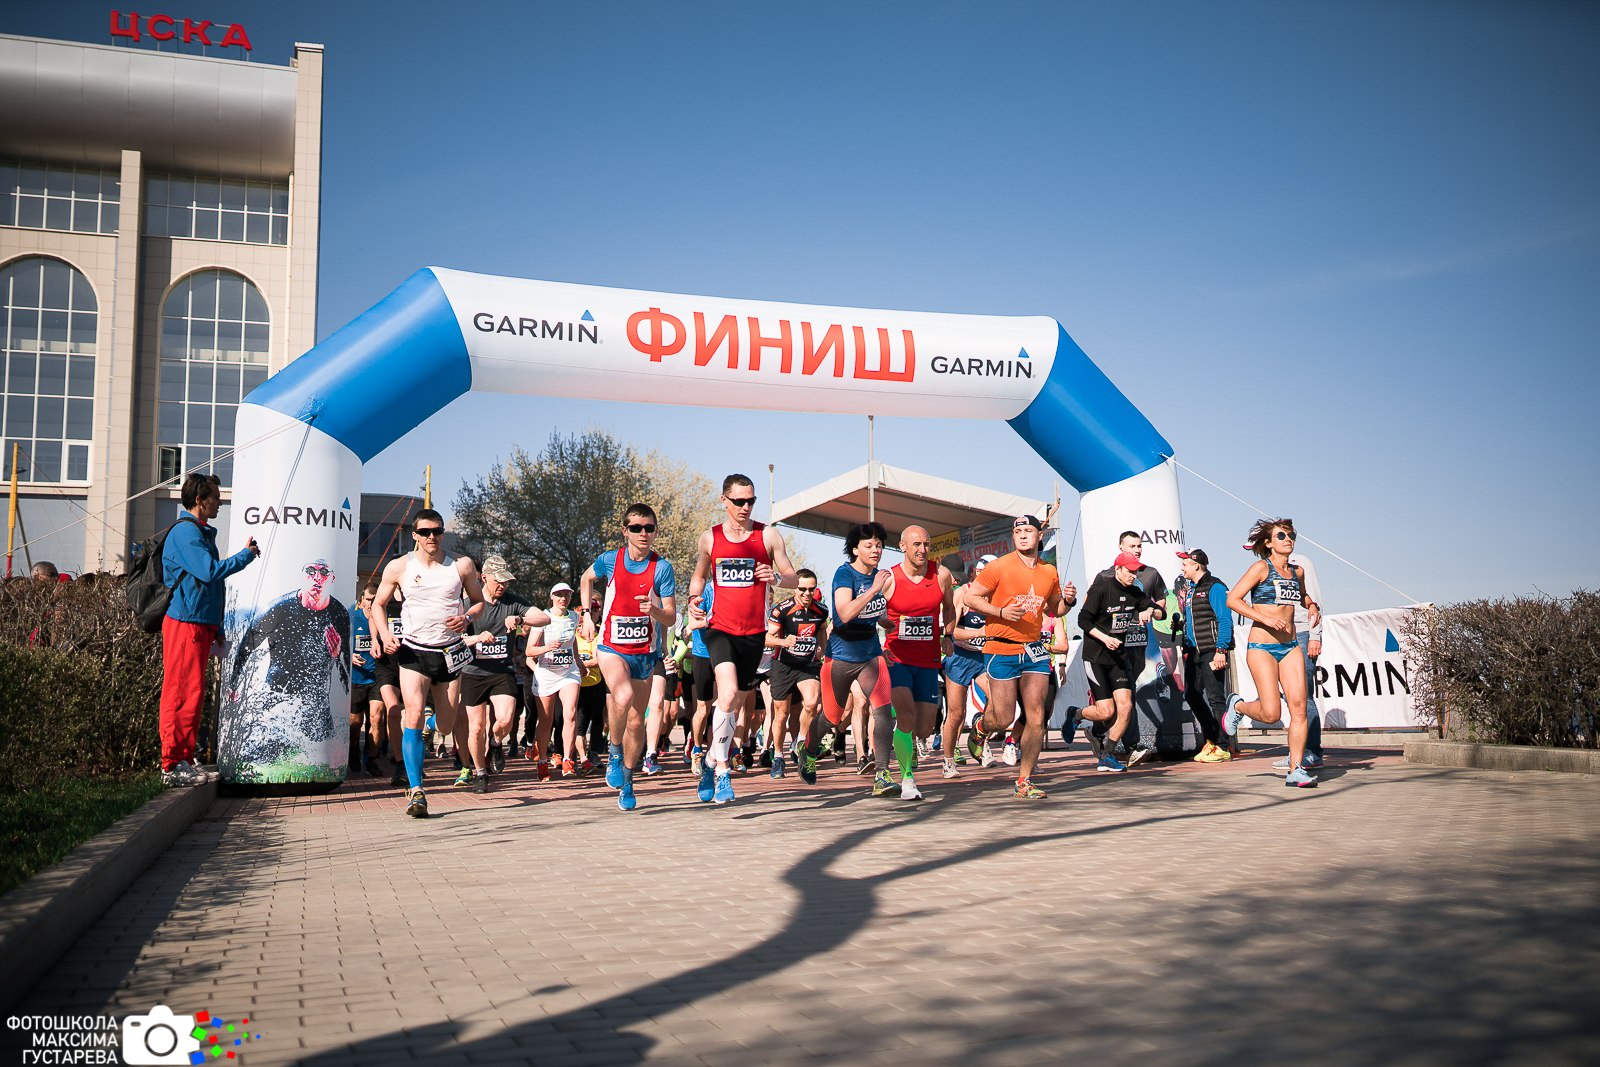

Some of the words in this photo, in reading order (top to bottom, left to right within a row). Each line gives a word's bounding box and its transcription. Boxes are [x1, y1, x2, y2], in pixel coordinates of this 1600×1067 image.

[110, 10, 253, 50] ЦСКА
[473, 312, 599, 344] GARMIN
[626, 307, 916, 382] ФИНИШ
[930, 355, 1033, 379] GARMIN
[244, 506, 352, 531] GARMIN
[722, 568, 754, 581] 2049
[1281, 589, 1302, 601] 2025
[866, 597, 887, 612] 2059
[617, 626, 649, 638] 2060
[905, 625, 933, 636] 2036
[1127, 633, 1147, 642] 2009
[482, 644, 507, 654] 2085
[794, 643, 816, 652] 2074
[1031, 645, 1048, 657] 204
[1314, 659, 1411, 699] RMIN
